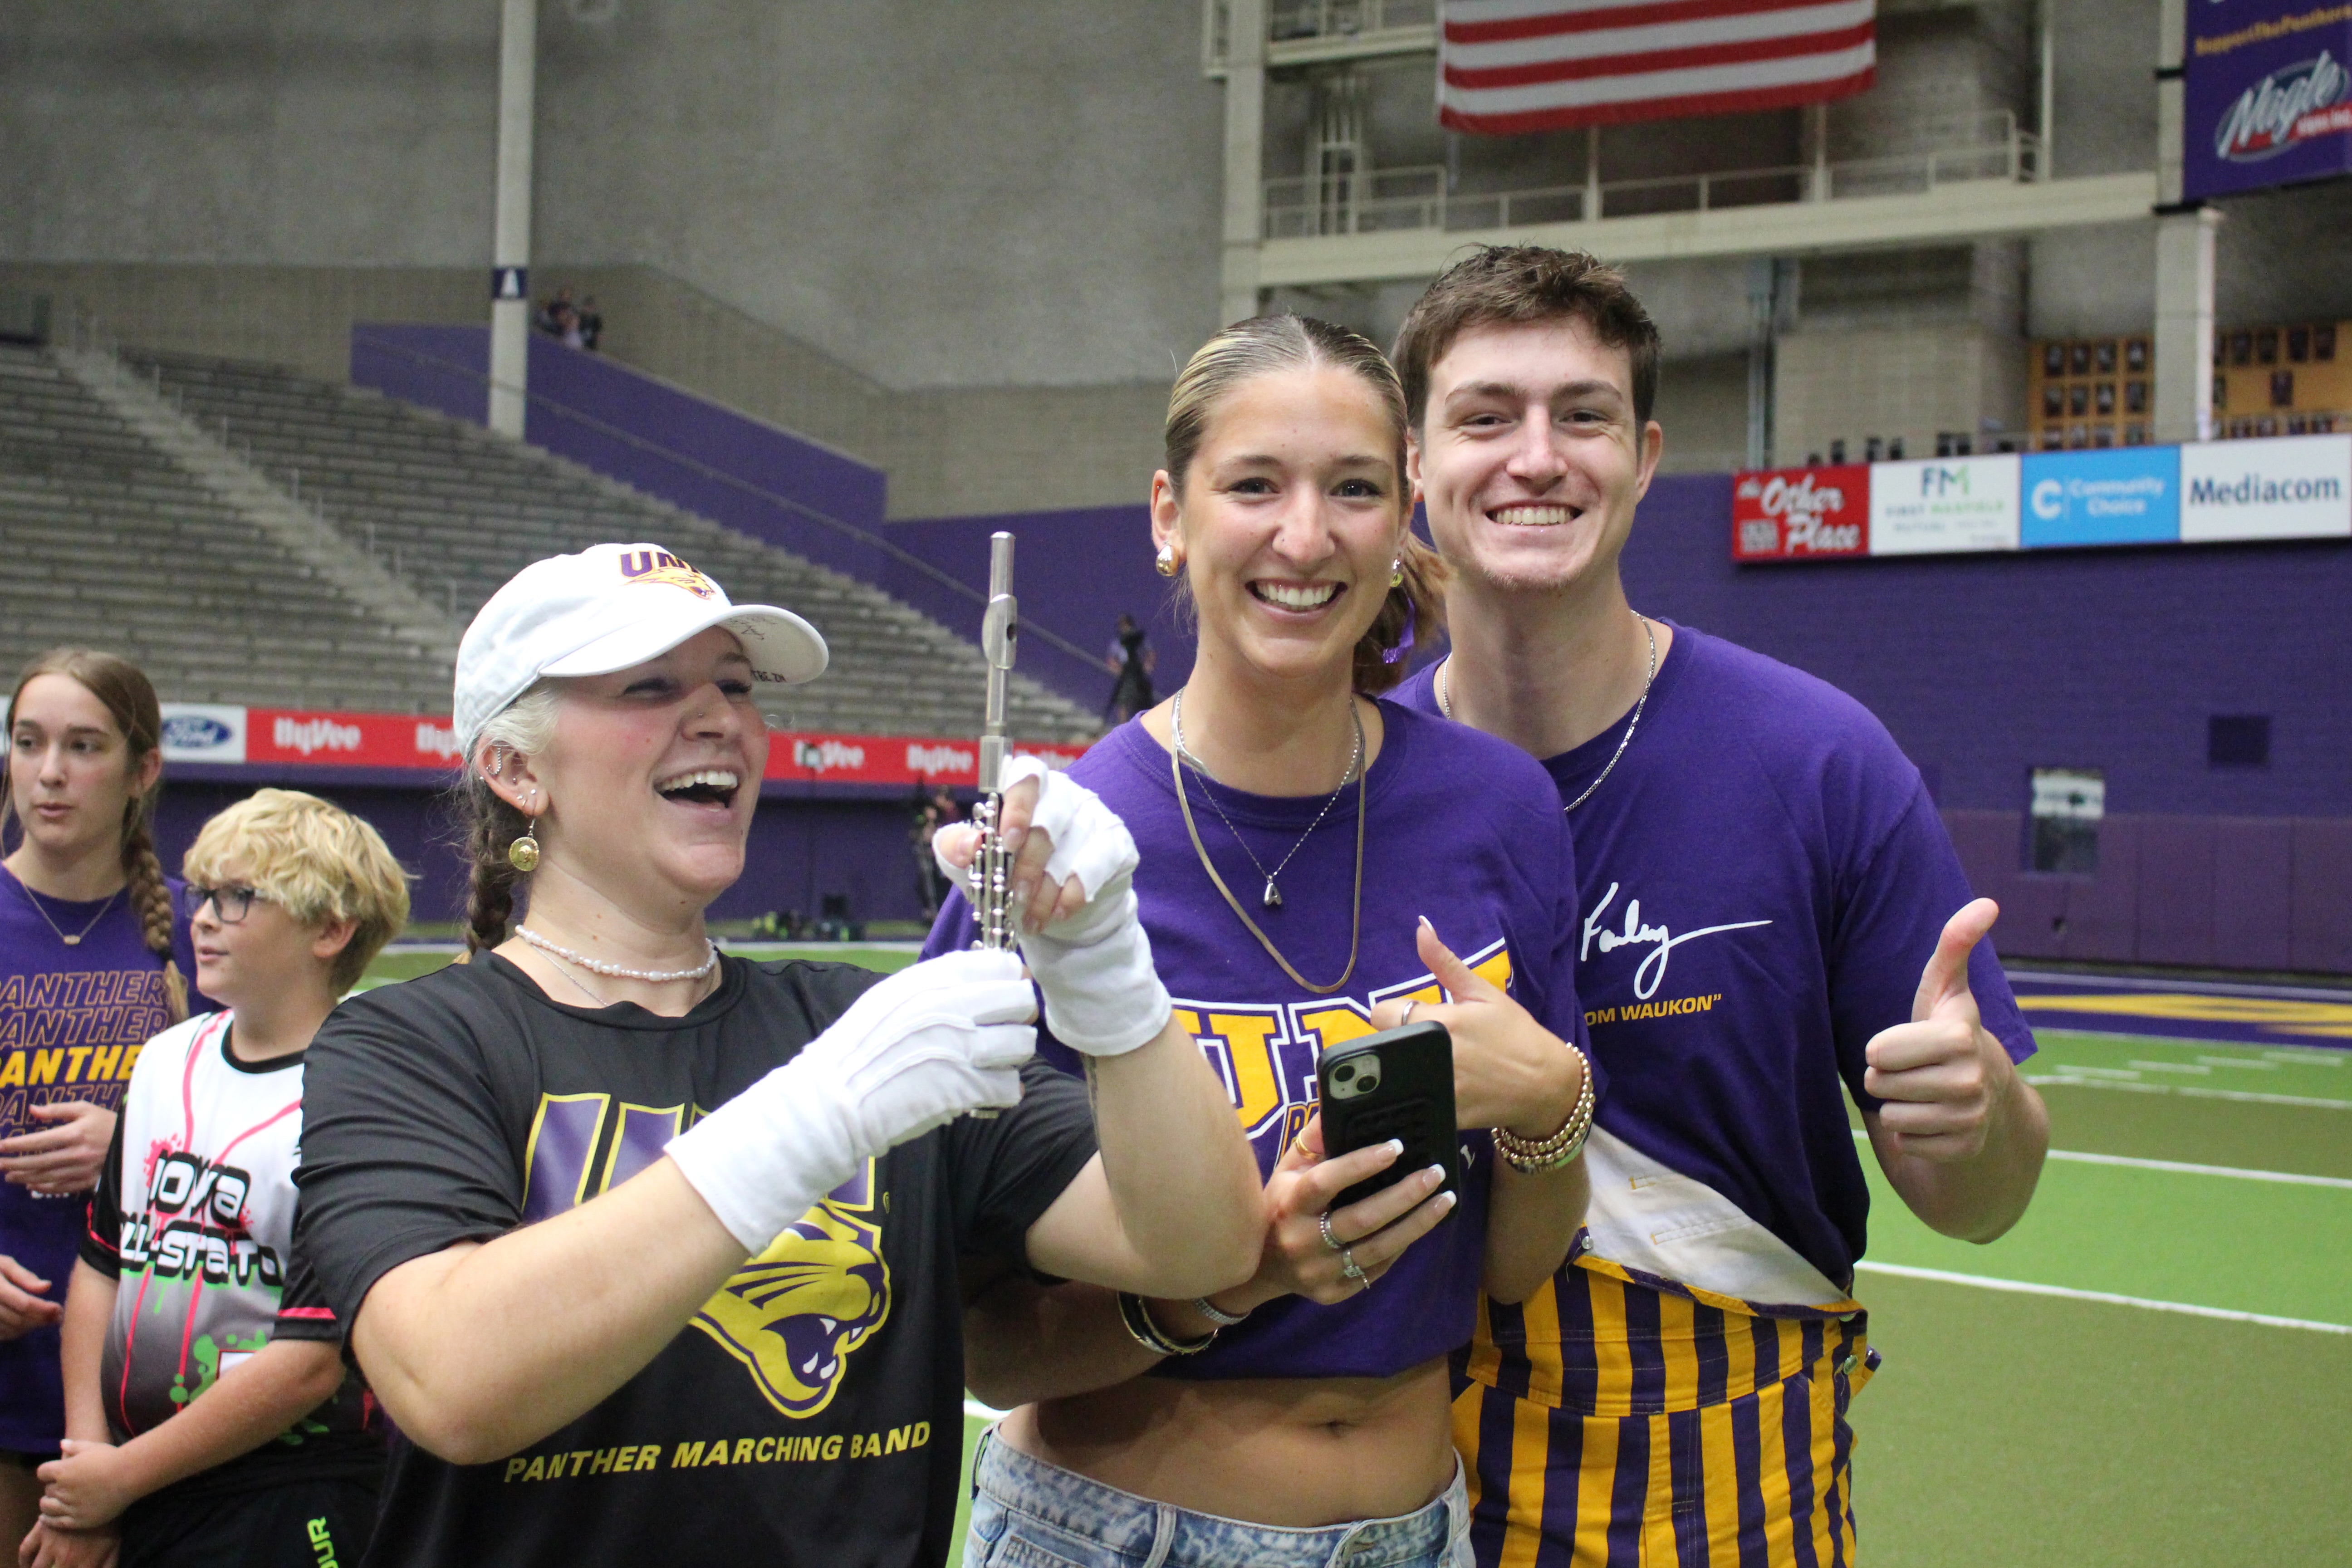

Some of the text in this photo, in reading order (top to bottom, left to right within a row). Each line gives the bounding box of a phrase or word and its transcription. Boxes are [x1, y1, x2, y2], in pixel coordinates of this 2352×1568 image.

[1760, 472, 1844, 516] Other
[1921, 464, 1970, 496] FM
[2190, 473, 2340, 506] Mediacom
[1784, 512, 1861, 557] Place
[617, 550, 703, 578] UN
[794, 739, 865, 773] HVee
[0, 970, 166, 1010] ANTHER
[0, 1006, 168, 1049] ANTHER
[1584, 1007, 1616, 1026] OM
[0, 1045, 145, 1089] ANTHE
[504, 1421, 931, 1483] PANTHER MARCHING BAND
